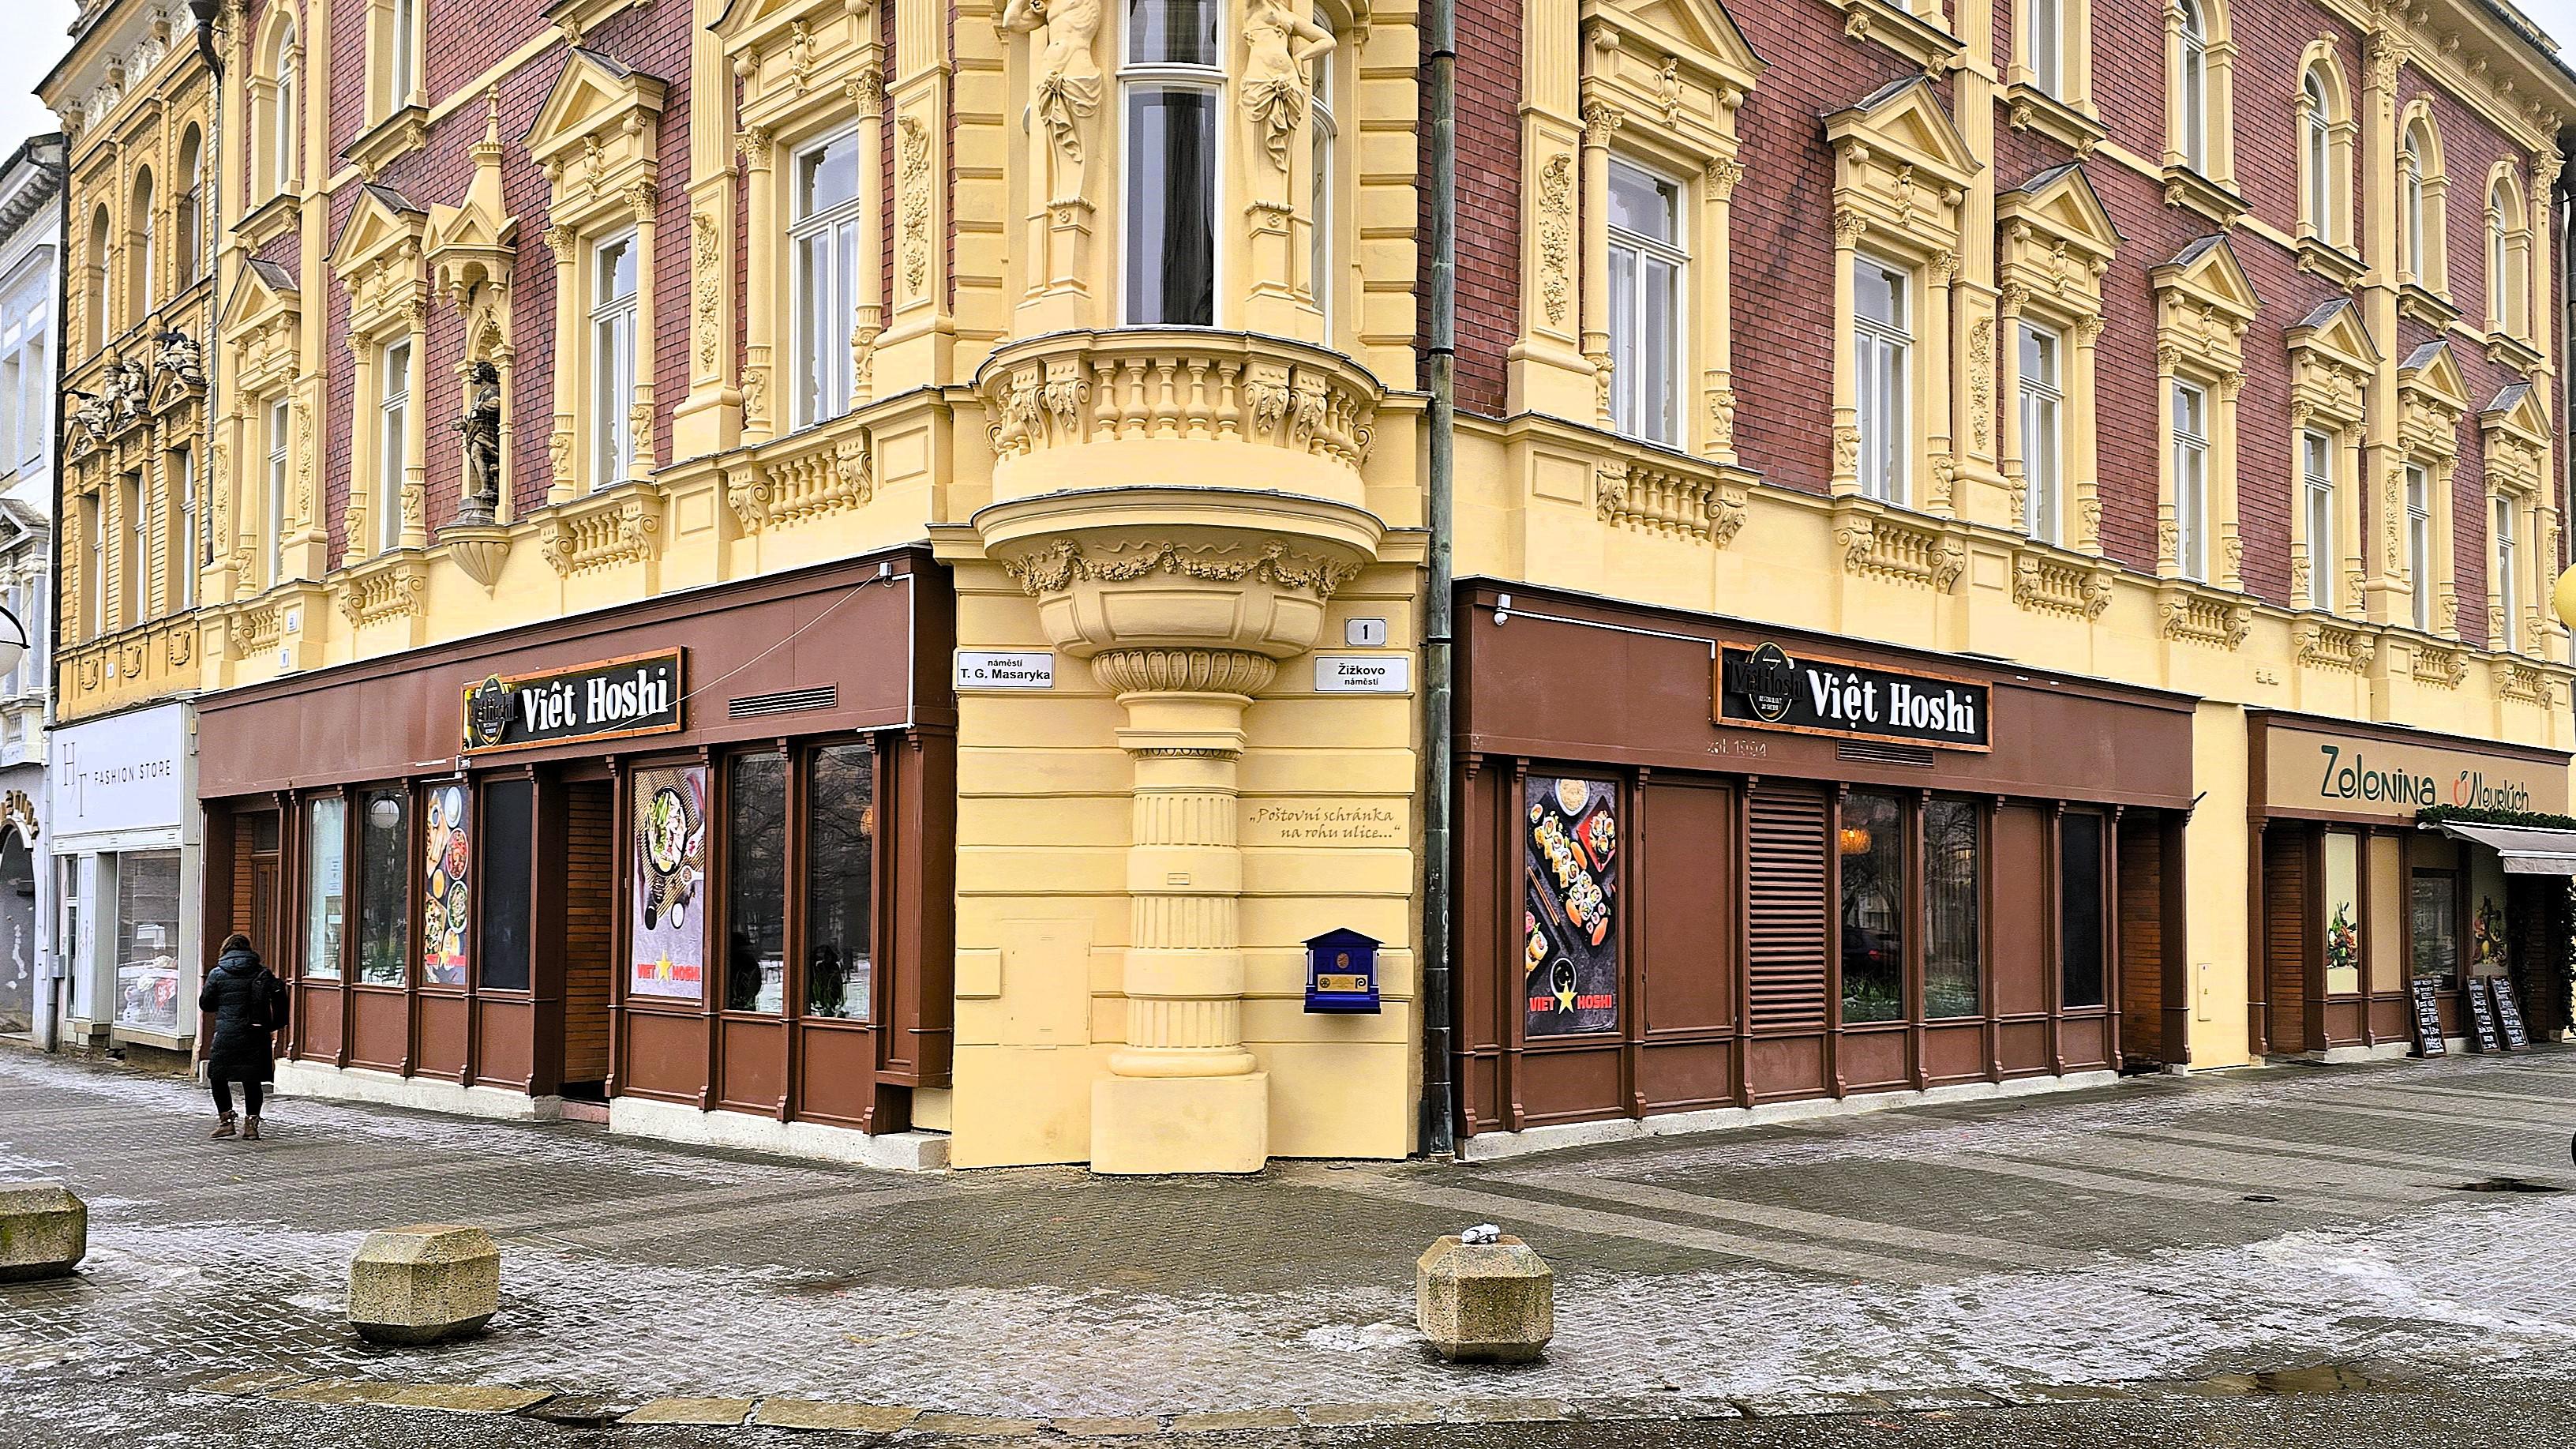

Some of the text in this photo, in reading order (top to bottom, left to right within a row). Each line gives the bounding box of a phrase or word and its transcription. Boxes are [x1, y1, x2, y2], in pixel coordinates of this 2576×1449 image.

[1363, 624, 1369, 640] 1
[960, 668, 1051, 682] T. G. Masaryka
[1337, 663, 1385, 675] Žižkovo
[586, 667, 669, 724] Hoshi
[1888, 682, 1975, 734] Hoshi
[94, 760, 171, 786] FASHION STORE
[2321, 745, 2436, 806] Zelenina
[1324, 807, 1394, 822] schránka
[1281, 829, 1303, 839] na
[1305, 824, 1338, 839] rohu
[637, 964, 656, 980] VIET
[1529, 995, 1613, 1012] VIET HOSHI
